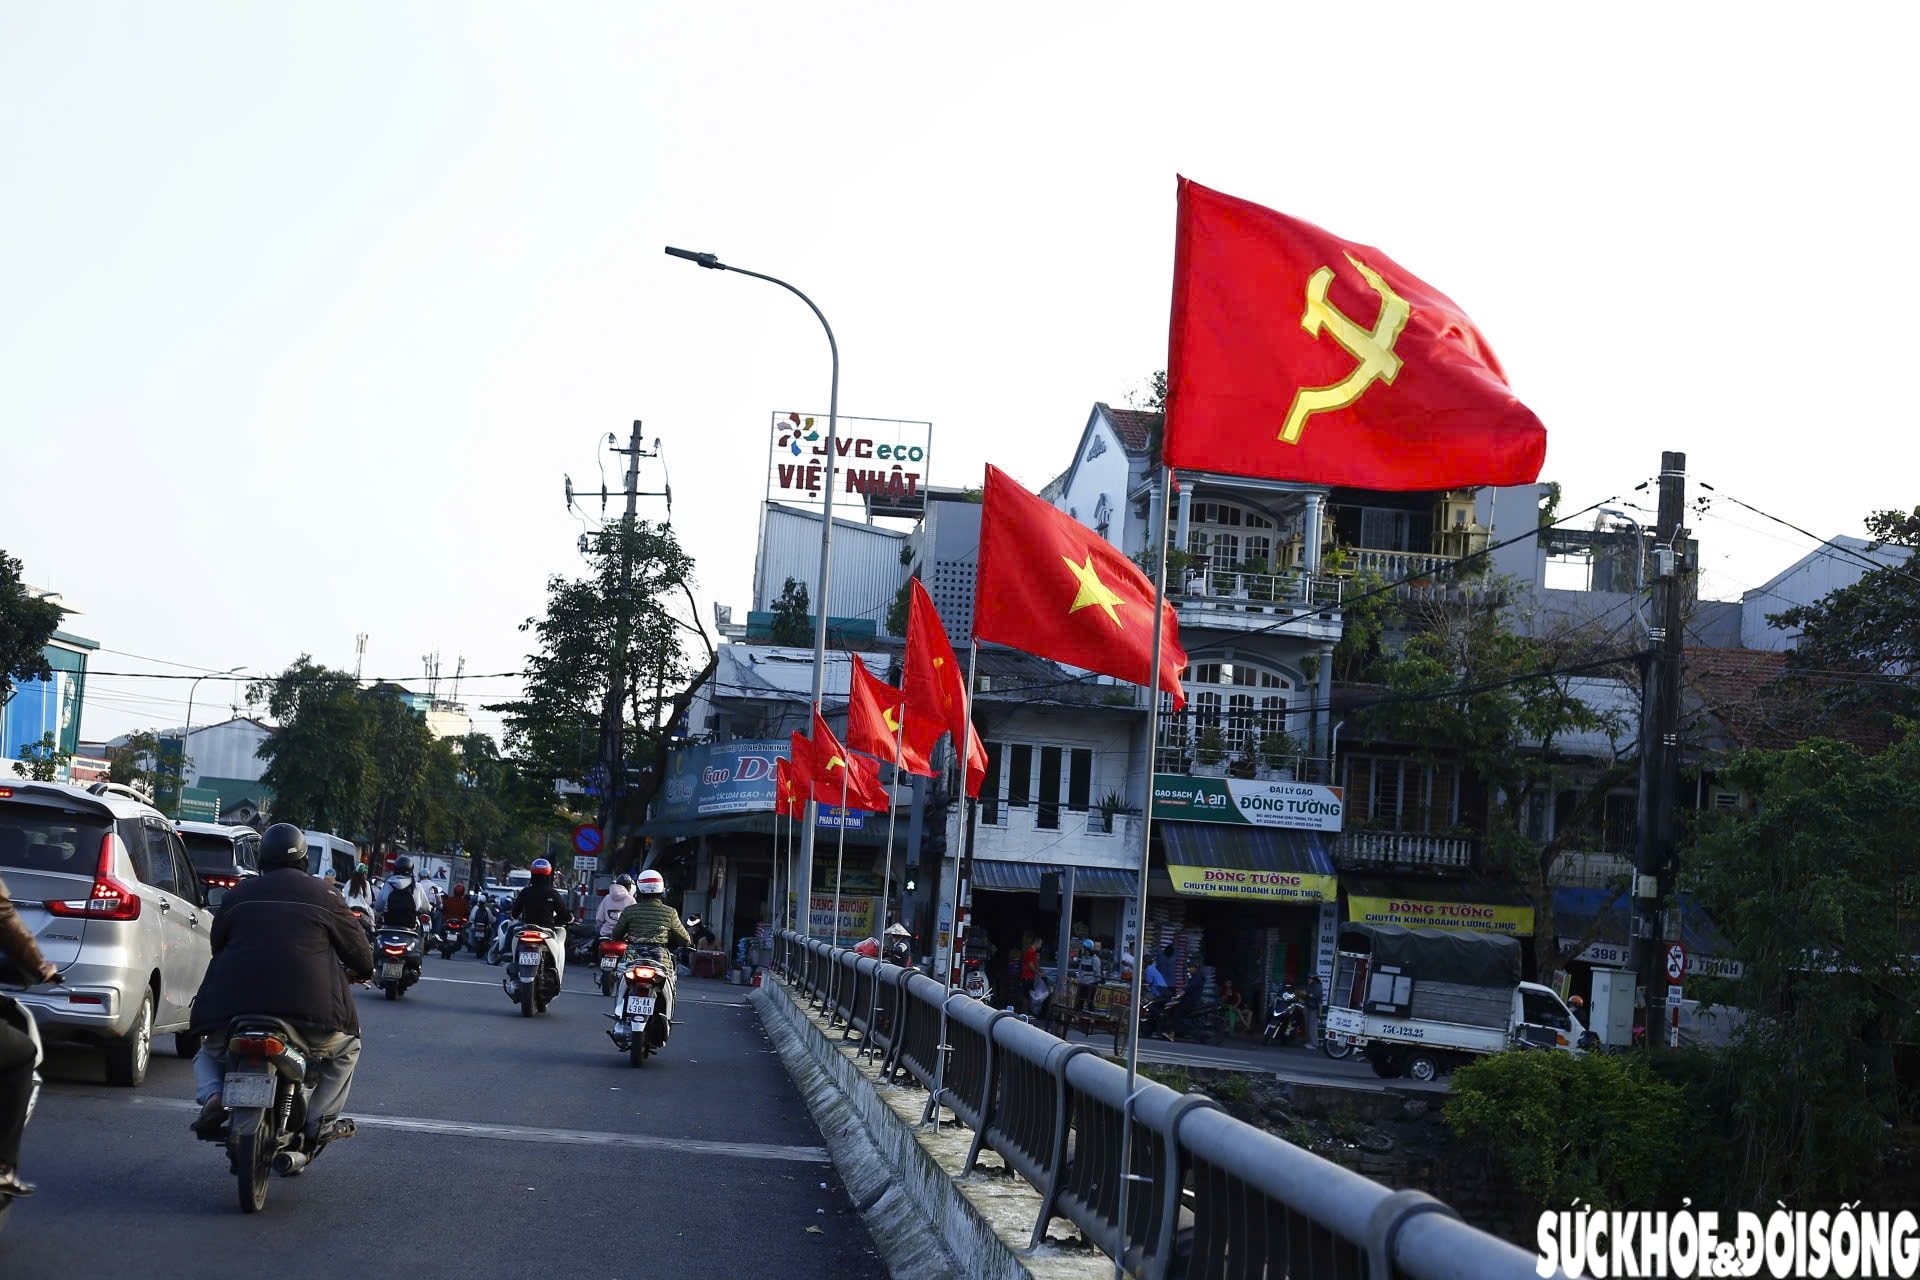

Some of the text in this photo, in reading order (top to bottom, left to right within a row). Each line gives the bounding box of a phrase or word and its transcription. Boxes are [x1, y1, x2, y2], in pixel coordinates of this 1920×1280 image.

[812, 436, 924, 462] JVC eco
[845, 464, 921, 503] NHẬT
[703, 765, 730, 788] Gạo
[739, 791, 759, 800] GẠO
[1154, 789, 1193, 800] GẠO SẠCH
[1269, 785, 1313, 798] ĐẠI LÝ GẠO
[1240, 795, 1341, 816] ĐÔNG TƯỜNG
[845, 817, 861, 827] TRINH
[1250, 872, 1301, 886] TƯỜNG
[1183, 881, 1217, 891] CHUYÊN
[1218, 884, 1239, 893] KINH
[1240, 885, 1269, 895] DOANH
[810, 897, 833, 910] UANG
[1438, 903, 1495, 919] TƯỜNG
[1365, 913, 1401, 923] CHUYÊN
[1404, 915, 1426, 925] KINH
[1428, 917, 1459, 927] DOANH
[1321, 935, 1334, 946] GẠO
[1591, 947, 1617, 961] 398
[1698, 960, 1739, 976] TRNH
